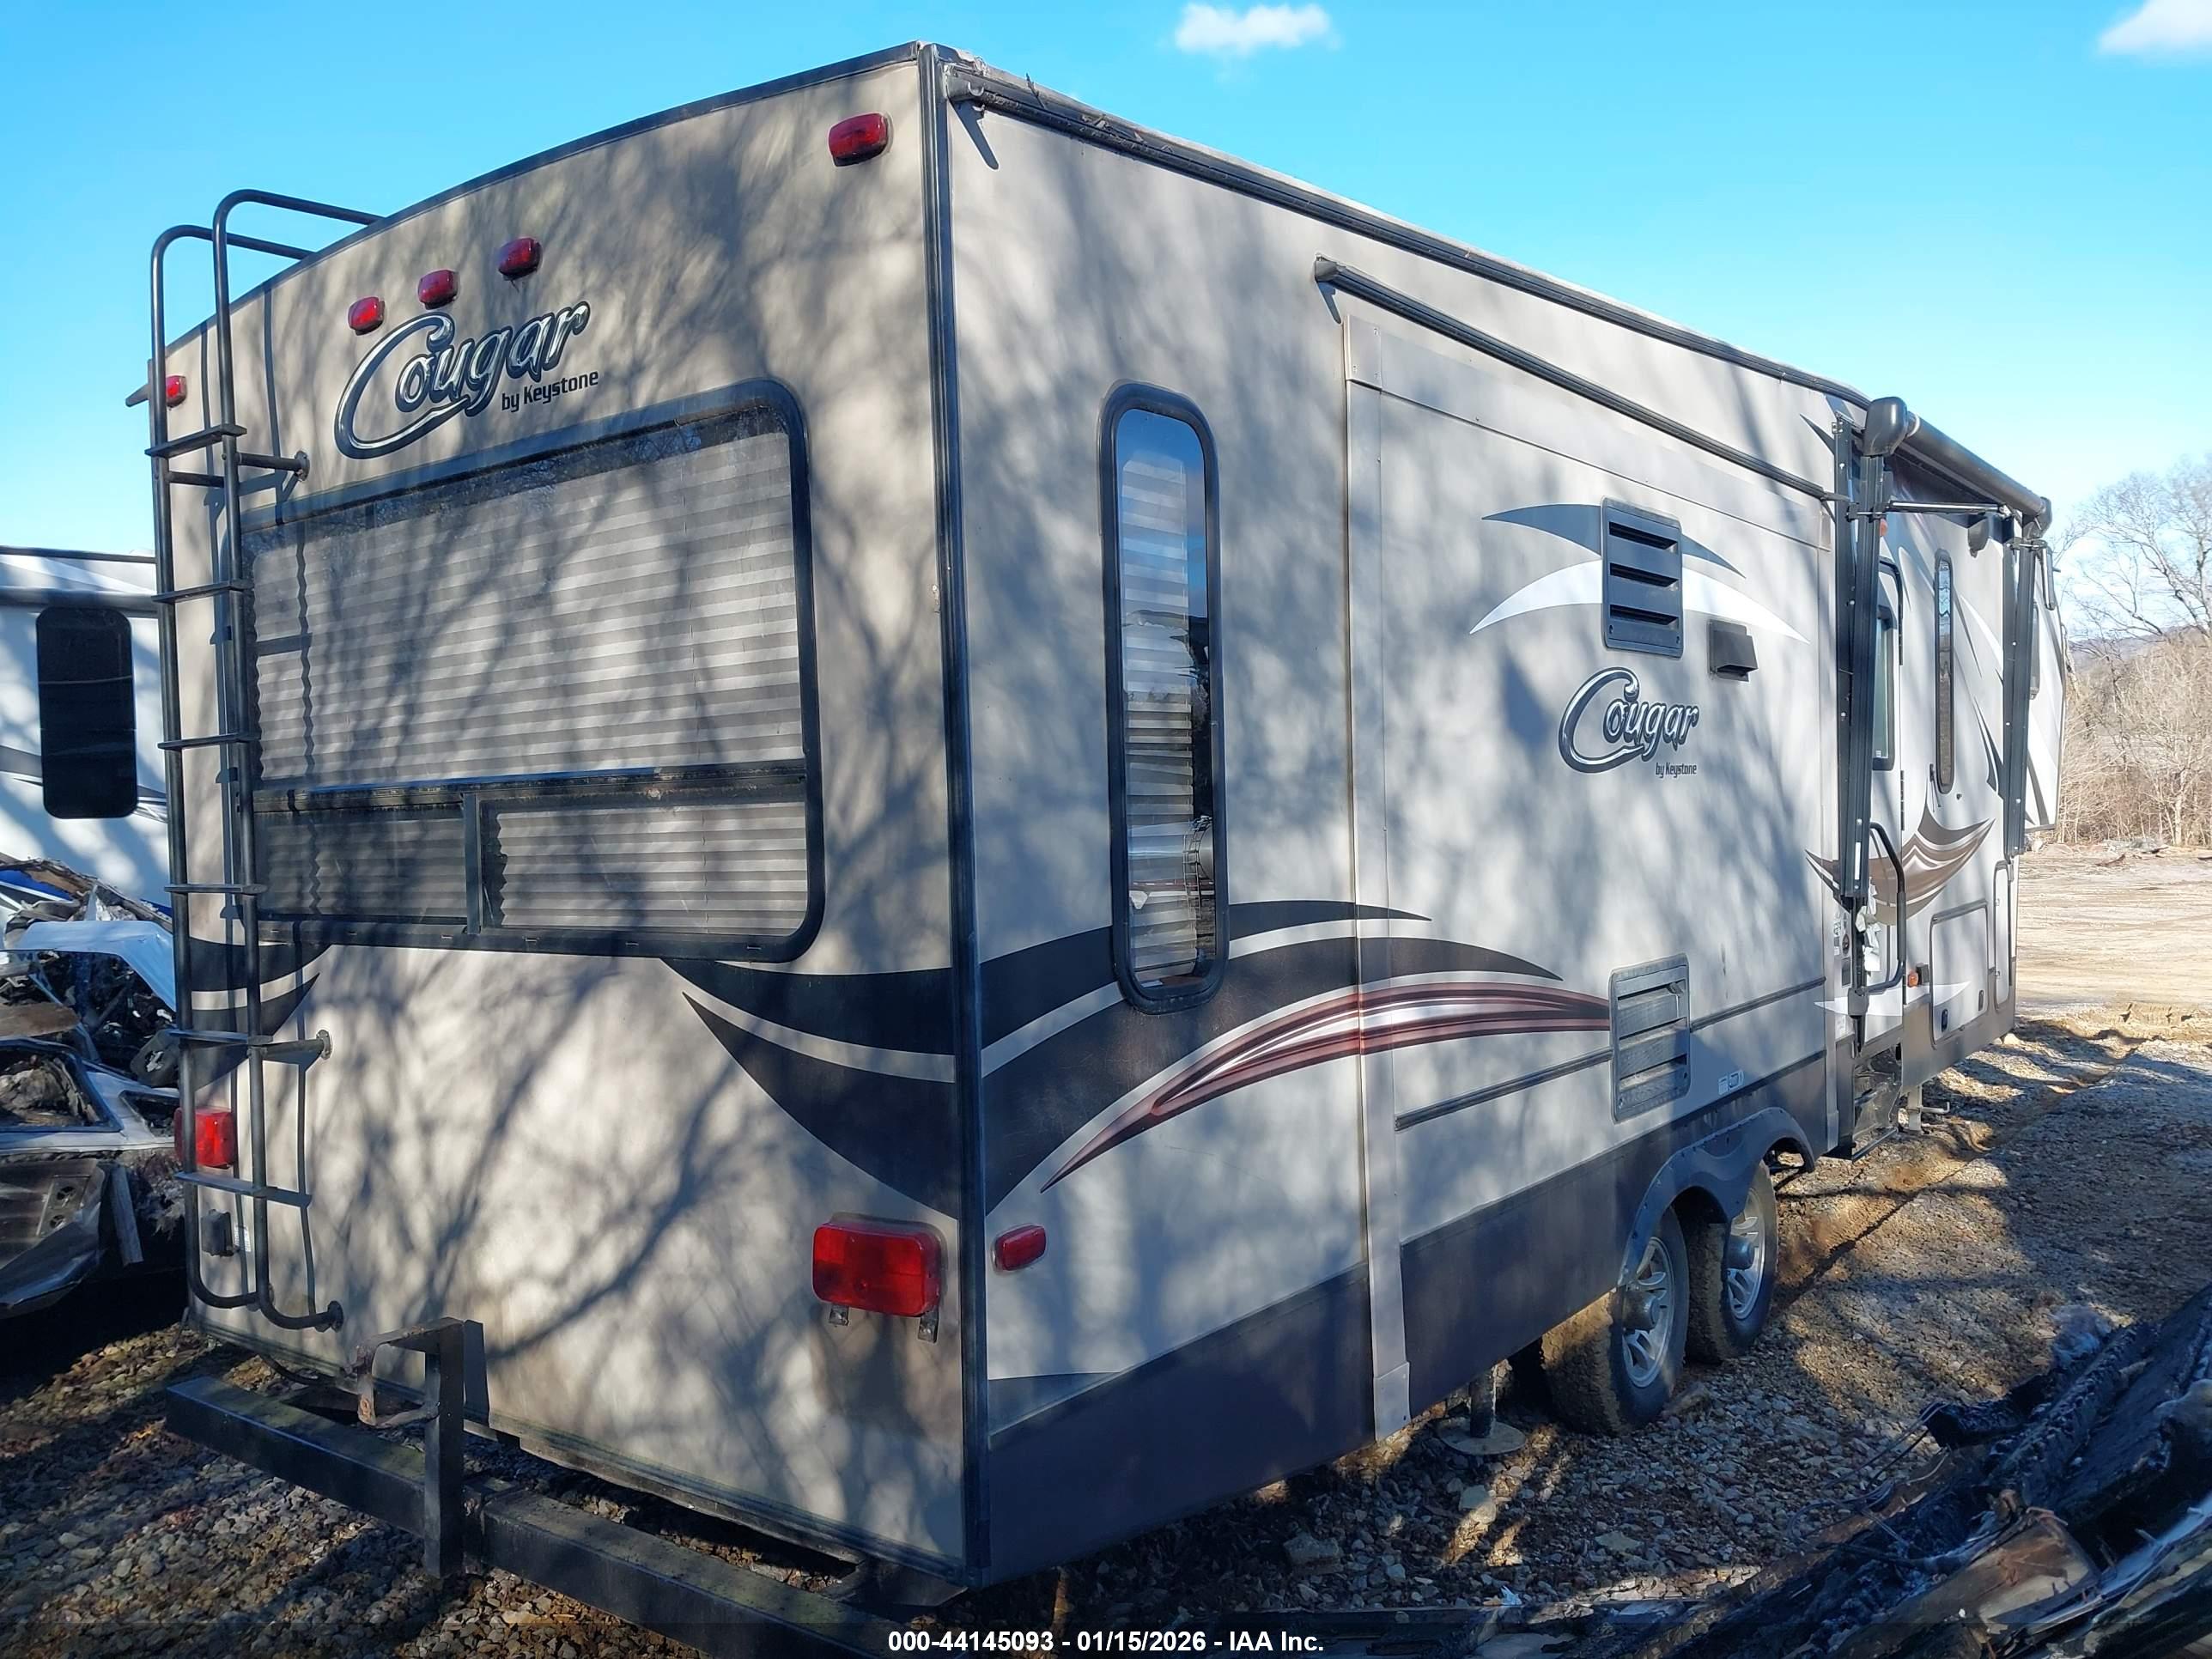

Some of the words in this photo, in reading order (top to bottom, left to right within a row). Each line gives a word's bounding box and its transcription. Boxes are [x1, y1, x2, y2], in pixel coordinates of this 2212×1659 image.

[334, 301, 591, 459] Cougar
[501, 392, 520, 413] by
[523, 371, 599, 404] Keystone
[1559, 666, 1699, 774] Cougar
[1656, 762, 1665, 779] by
[1666, 762, 1698, 779] Keystone
